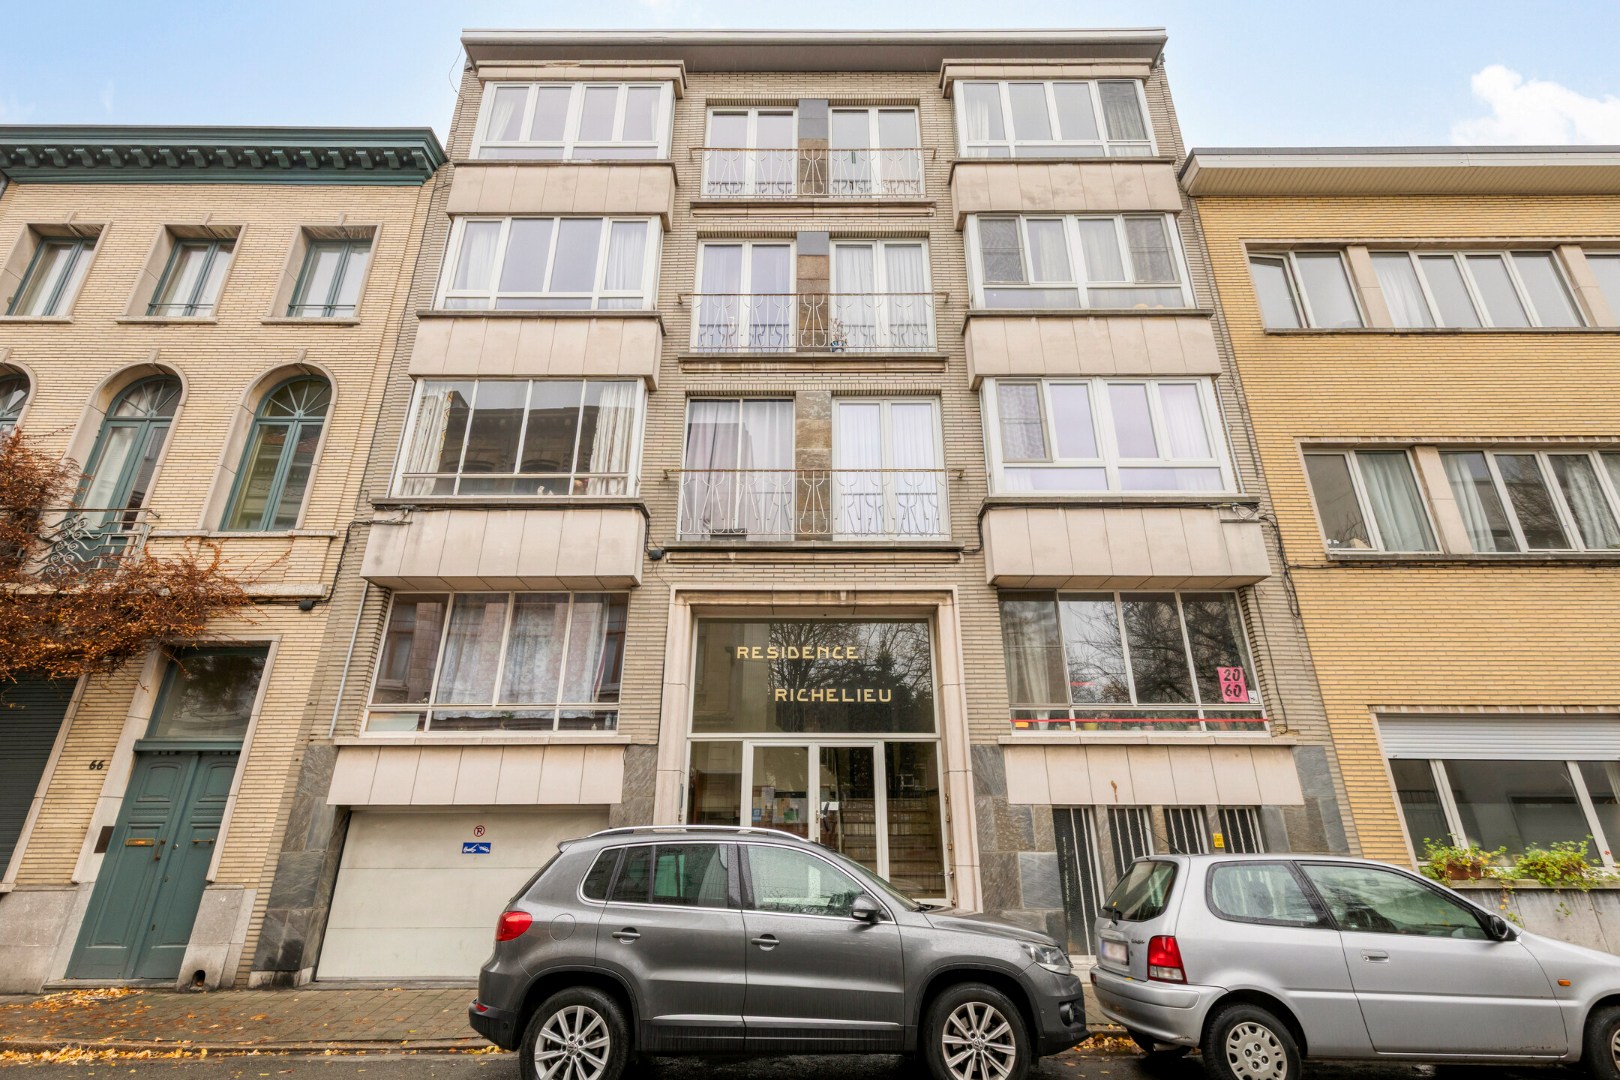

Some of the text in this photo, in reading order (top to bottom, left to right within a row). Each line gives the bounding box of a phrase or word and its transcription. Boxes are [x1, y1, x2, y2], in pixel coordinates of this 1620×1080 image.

[736, 646, 859, 659] RESIDENCE
[1223, 668, 1241, 682] 20
[774, 688, 892, 703] RICHELIEU
[1224, 683, 1242, 698] 60
[88, 759, 106, 771] 66
